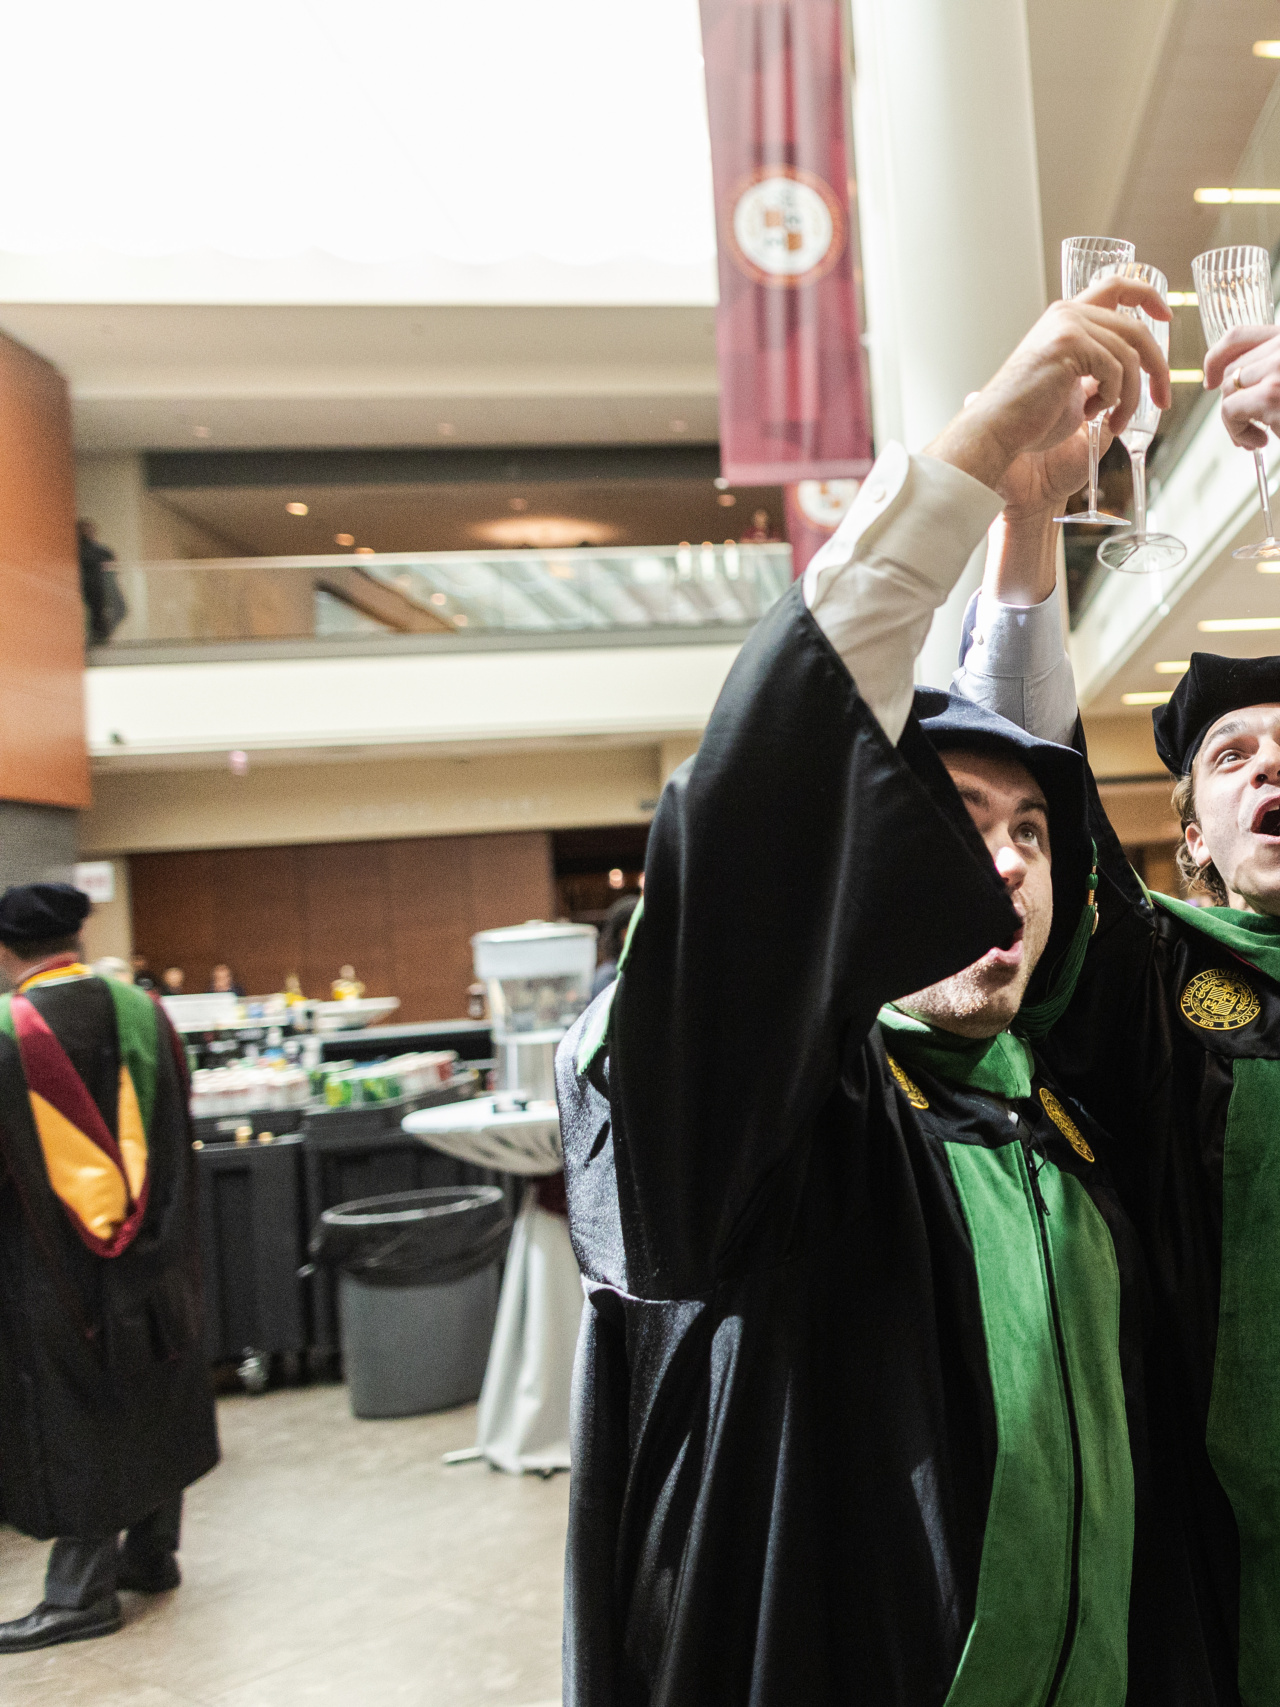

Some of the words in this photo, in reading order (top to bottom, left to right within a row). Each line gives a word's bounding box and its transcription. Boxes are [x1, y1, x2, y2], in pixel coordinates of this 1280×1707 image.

[1182, 979, 1202, 1007] LOYOLA
[1201, 970, 1252, 987] UNIVERSI
[1199, 1018, 1214, 1027] 1870
